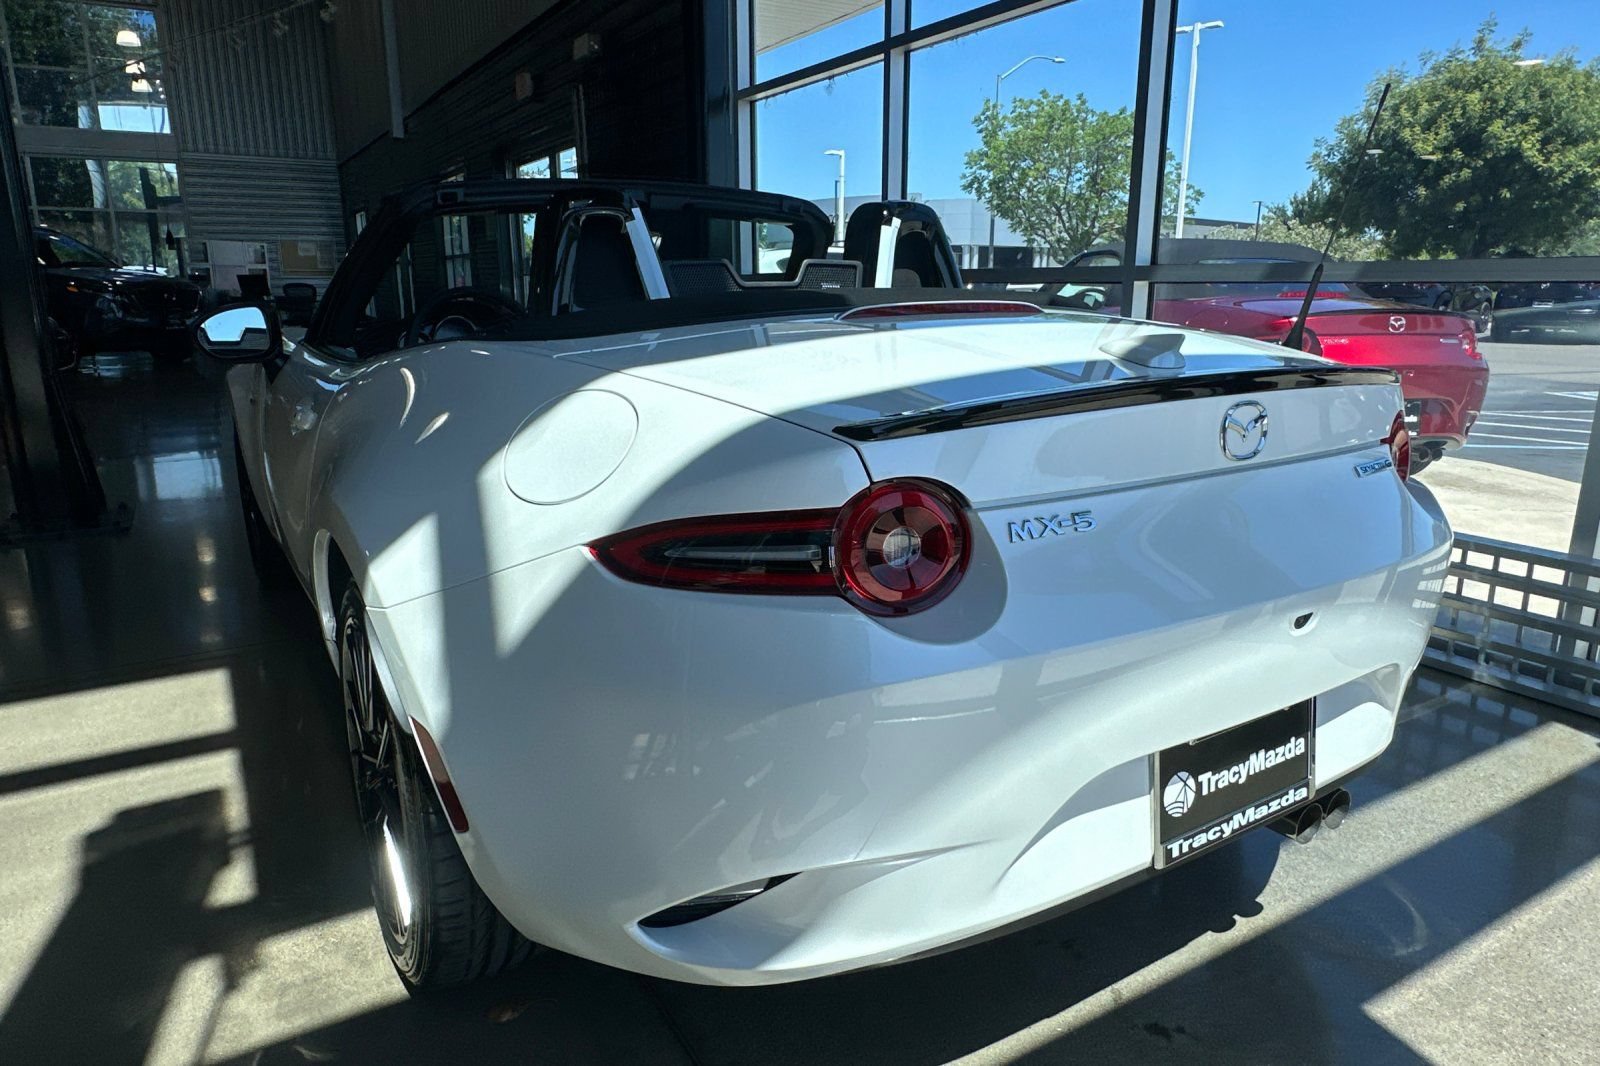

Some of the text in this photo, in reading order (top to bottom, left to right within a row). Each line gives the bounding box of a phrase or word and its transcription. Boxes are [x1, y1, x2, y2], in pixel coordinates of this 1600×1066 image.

[1007, 511, 1097, 543] MX-5
[1198, 736, 1305, 796] TracyMazda
[1167, 787, 1308, 858] TracyMazda
